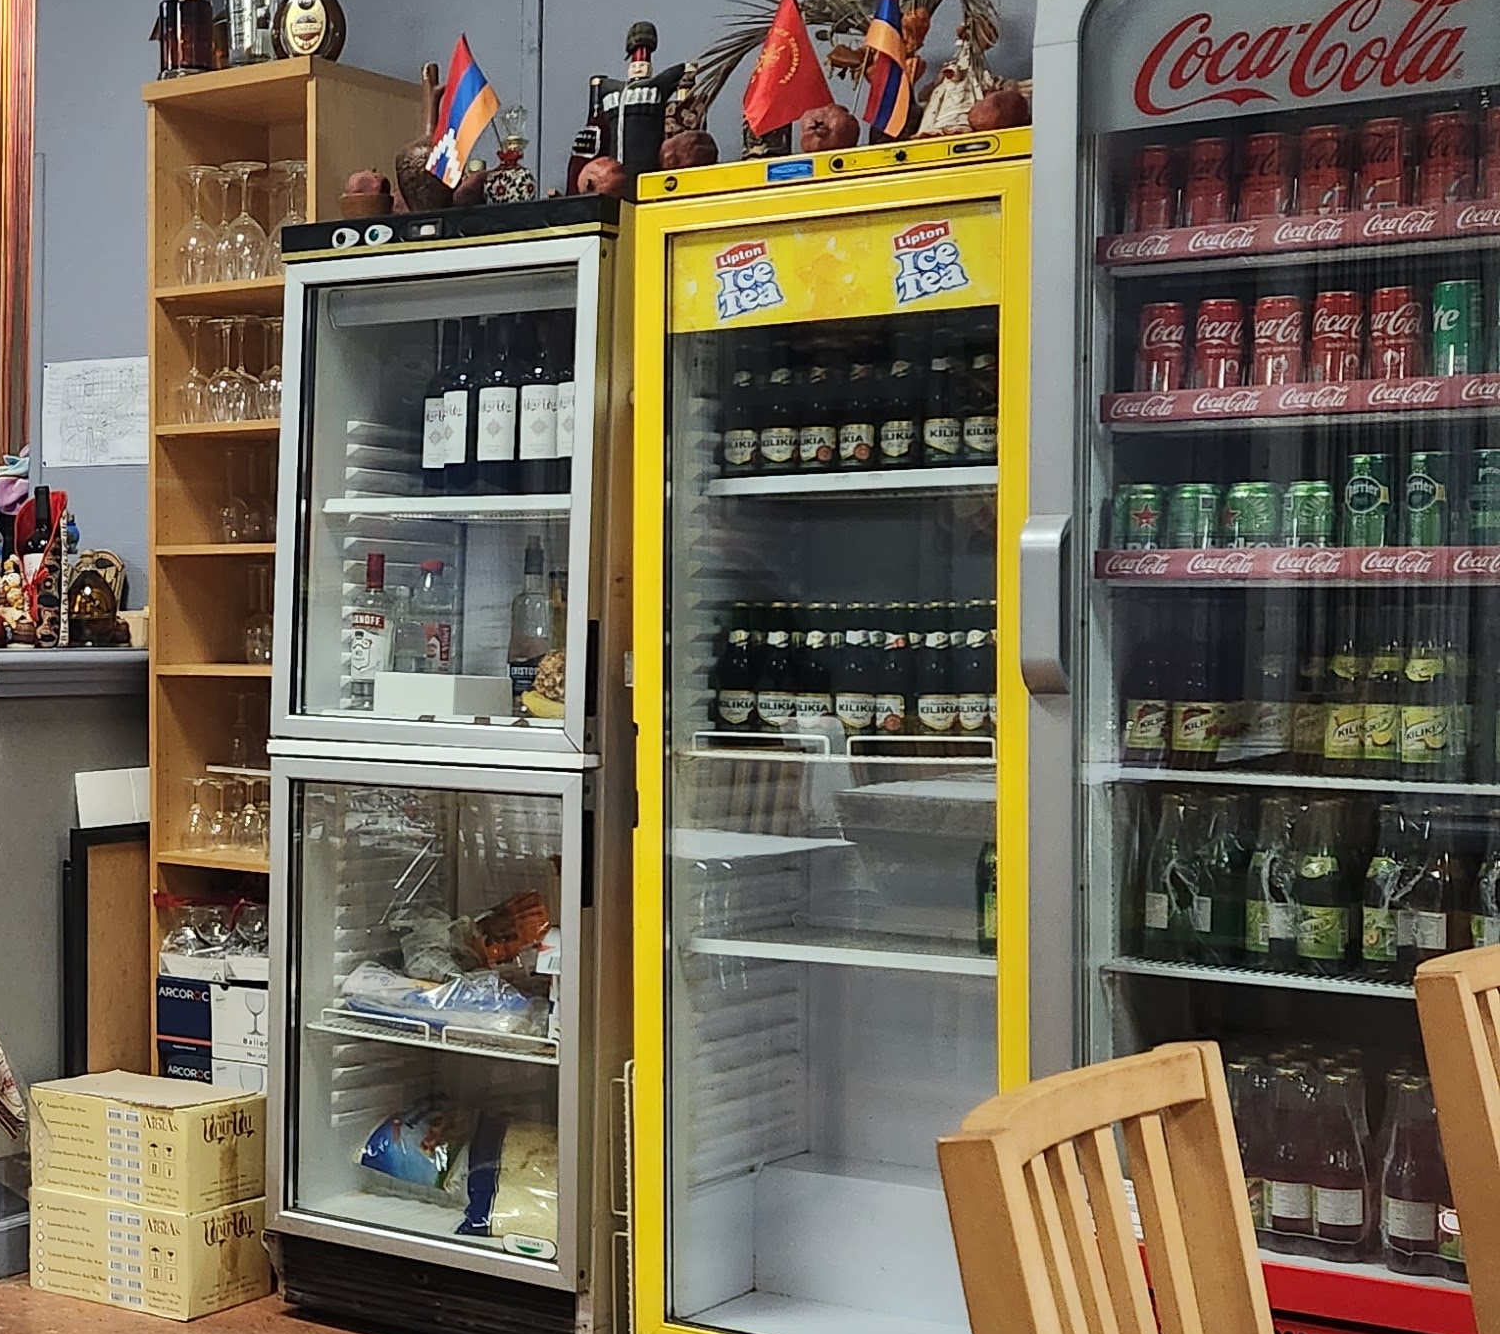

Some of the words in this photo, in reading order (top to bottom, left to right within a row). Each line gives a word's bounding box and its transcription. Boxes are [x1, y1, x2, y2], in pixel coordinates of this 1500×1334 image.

[1274, 217, 1348, 245] Coca-Cola
[1363, 210, 1440, 237] Coca-Cola
[896, 224, 946, 249] Lipton
[1106, 235, 1173, 260] Coca-Cola
[1188, 227, 1259, 252] Coca-Cola
[720, 245, 763, 268] Lipton
[895, 241, 960, 275] Ice
[718, 261, 775, 293] Ice
[896, 262, 970, 304] Tea
[718, 279, 784, 319] Tea
[1192, 390, 1263, 415] Coca-Cola
[1278, 384, 1350, 410] Coca-Cola
[1368, 380, 1444, 406] Coca-Cola
[1110, 394, 1178, 418] Coca-Cola
[1105, 553, 1172, 576] Coca-Cola
[1186, 552, 1256, 574] Coca-Cola
[1272, 549, 1344, 574] Coca-Cola
[1360, 550, 1437, 574] Coca-Cola
[158, 986, 211, 1003] ARCOROC
[167, 1064, 212, 1081] ARCOROC
